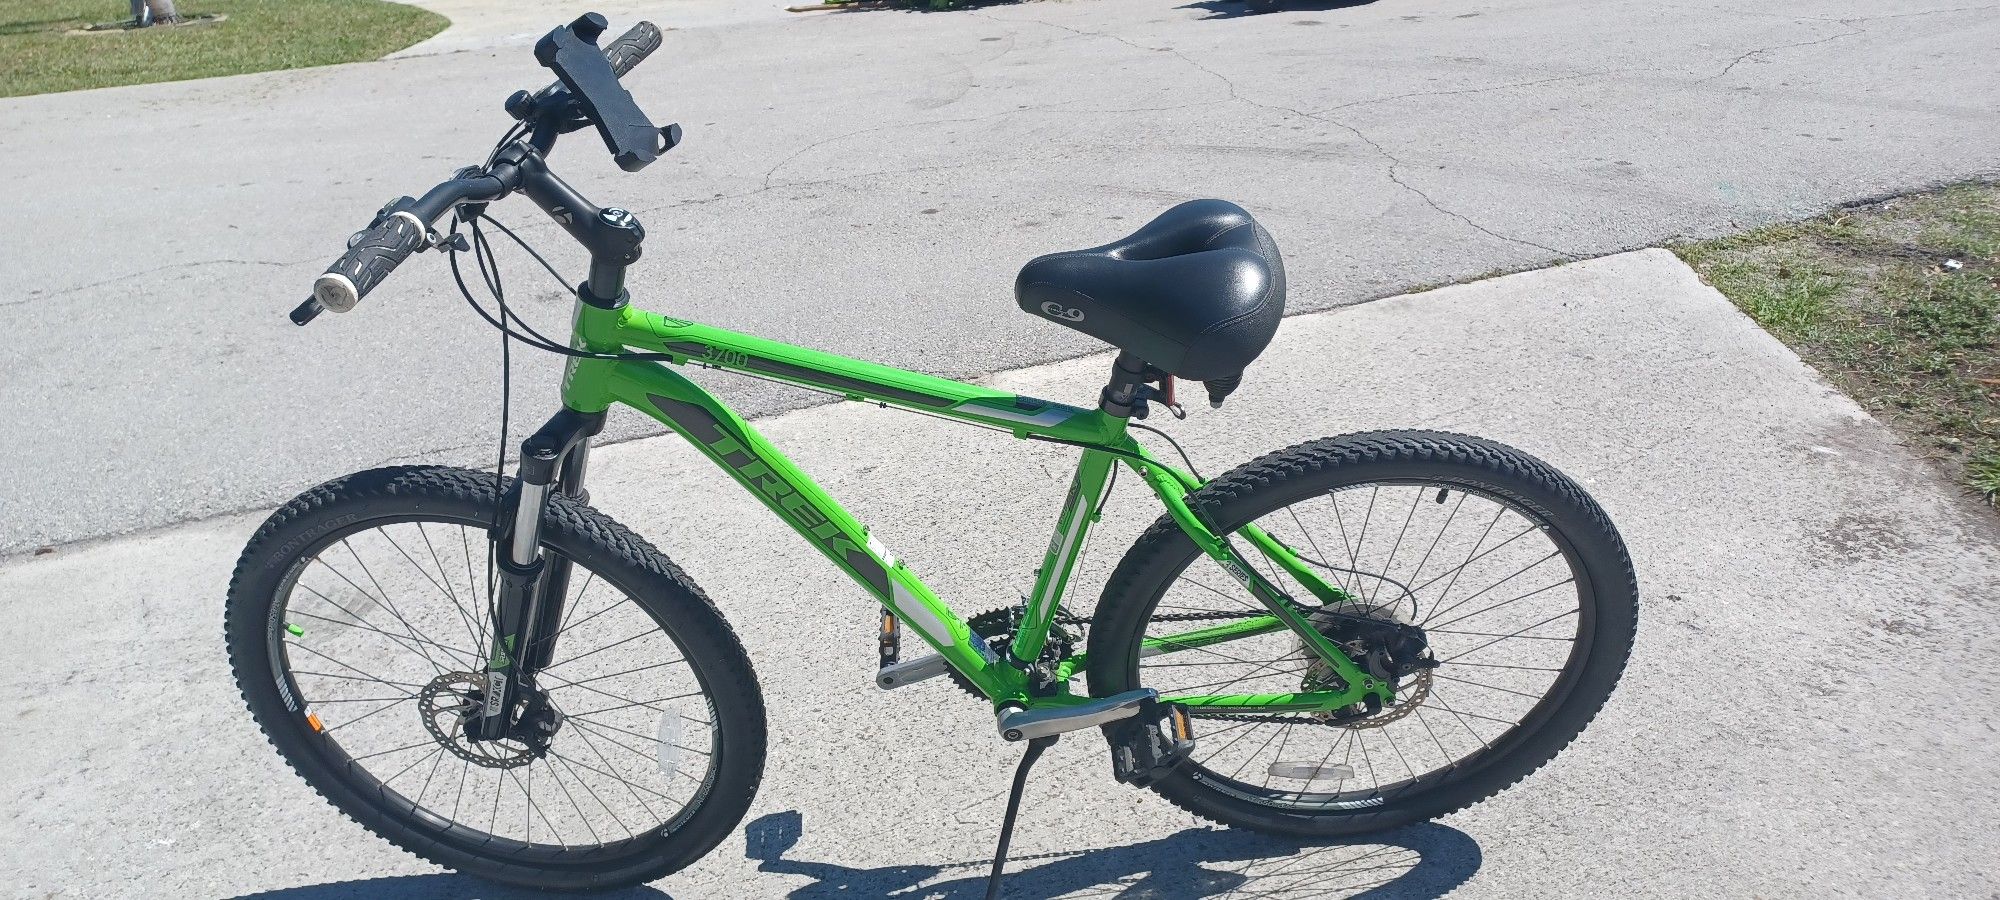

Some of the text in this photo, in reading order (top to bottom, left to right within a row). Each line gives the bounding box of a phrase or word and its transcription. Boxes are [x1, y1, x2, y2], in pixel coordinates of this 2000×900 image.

[702, 345, 749, 367] 3700
[709, 423, 866, 561] TREK
[1229, 564, 1249, 582] SERIES
